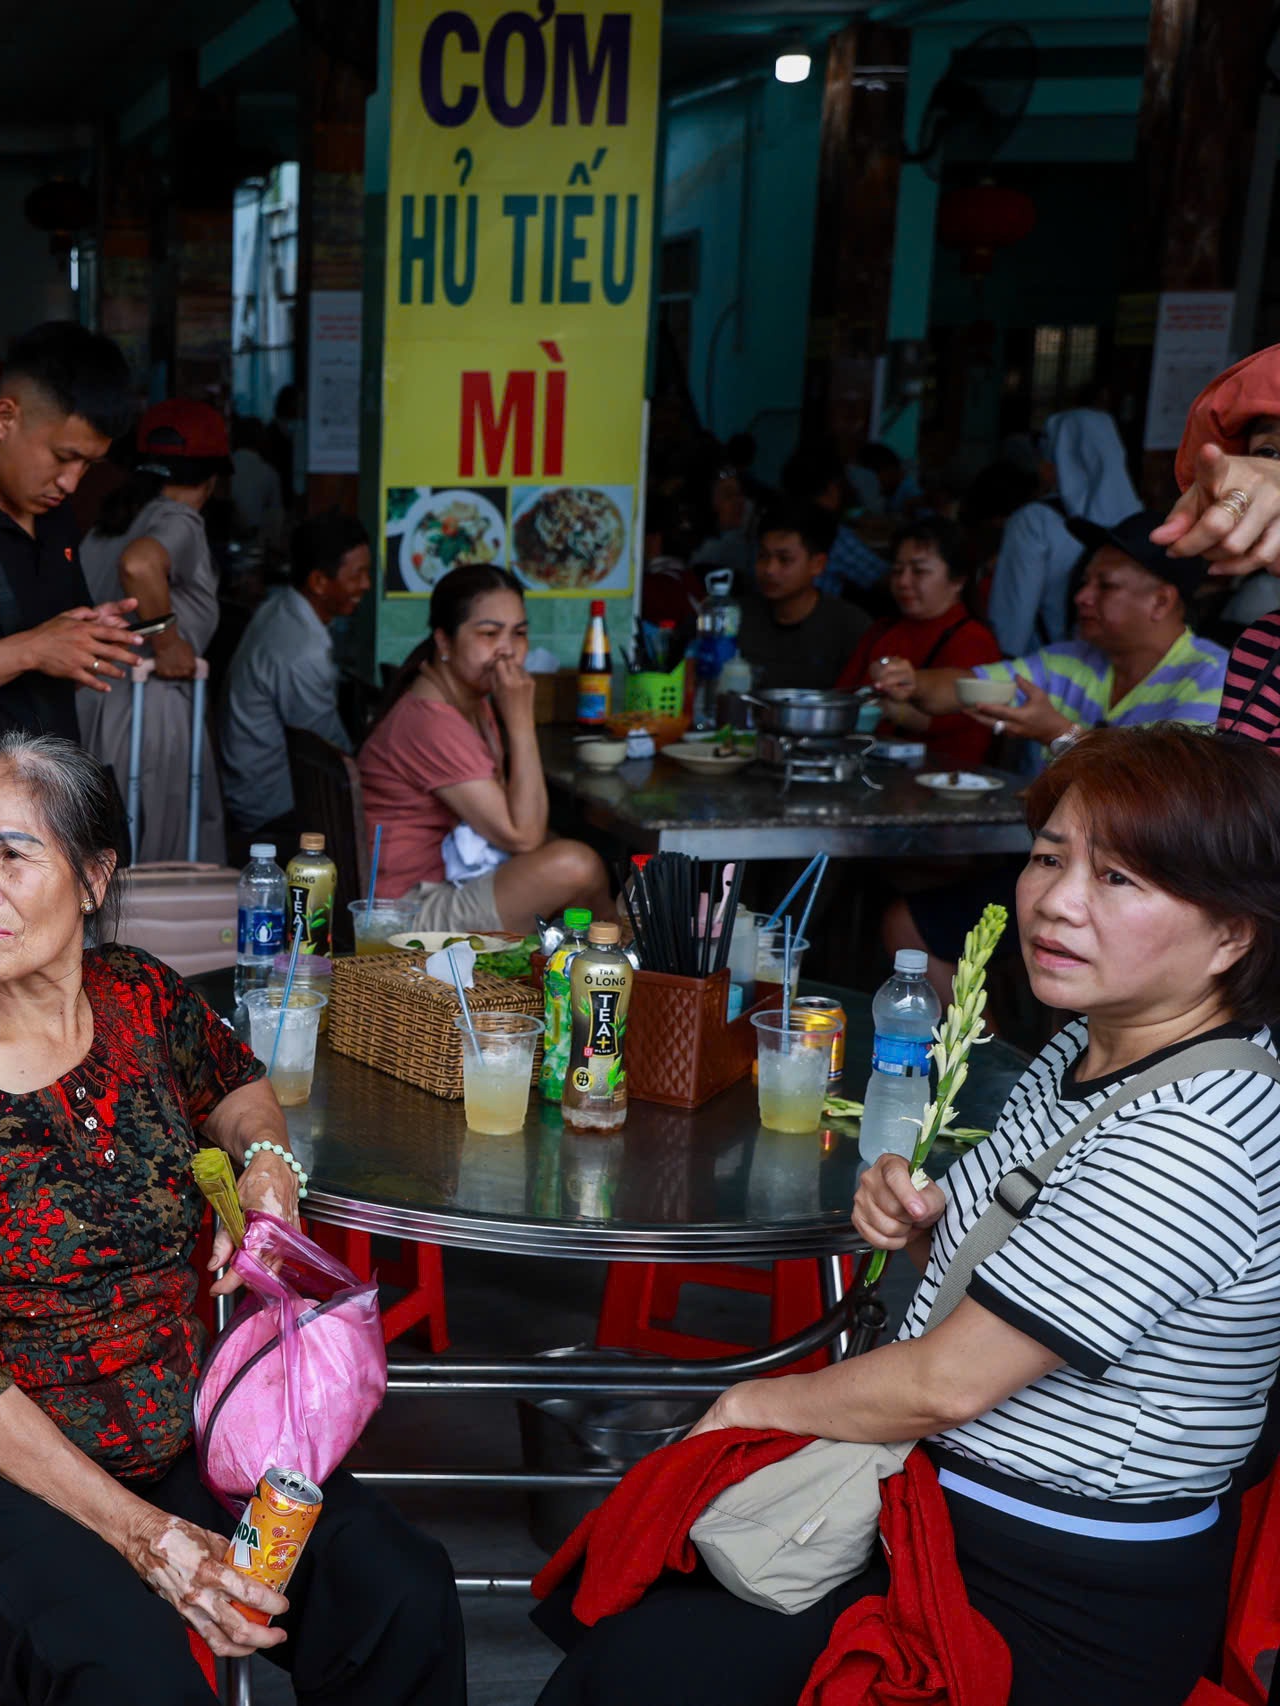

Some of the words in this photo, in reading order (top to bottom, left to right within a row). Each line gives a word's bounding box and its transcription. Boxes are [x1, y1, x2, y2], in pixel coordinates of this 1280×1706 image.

[419, 0, 632, 128] CƠM
[399, 148, 479, 307] HỦ
[503, 147, 639, 306] TIẾU
[458, 341, 567, 478] MÌ
[584, 973, 593, 984] Ô
[596, 977, 626, 987] LONG
